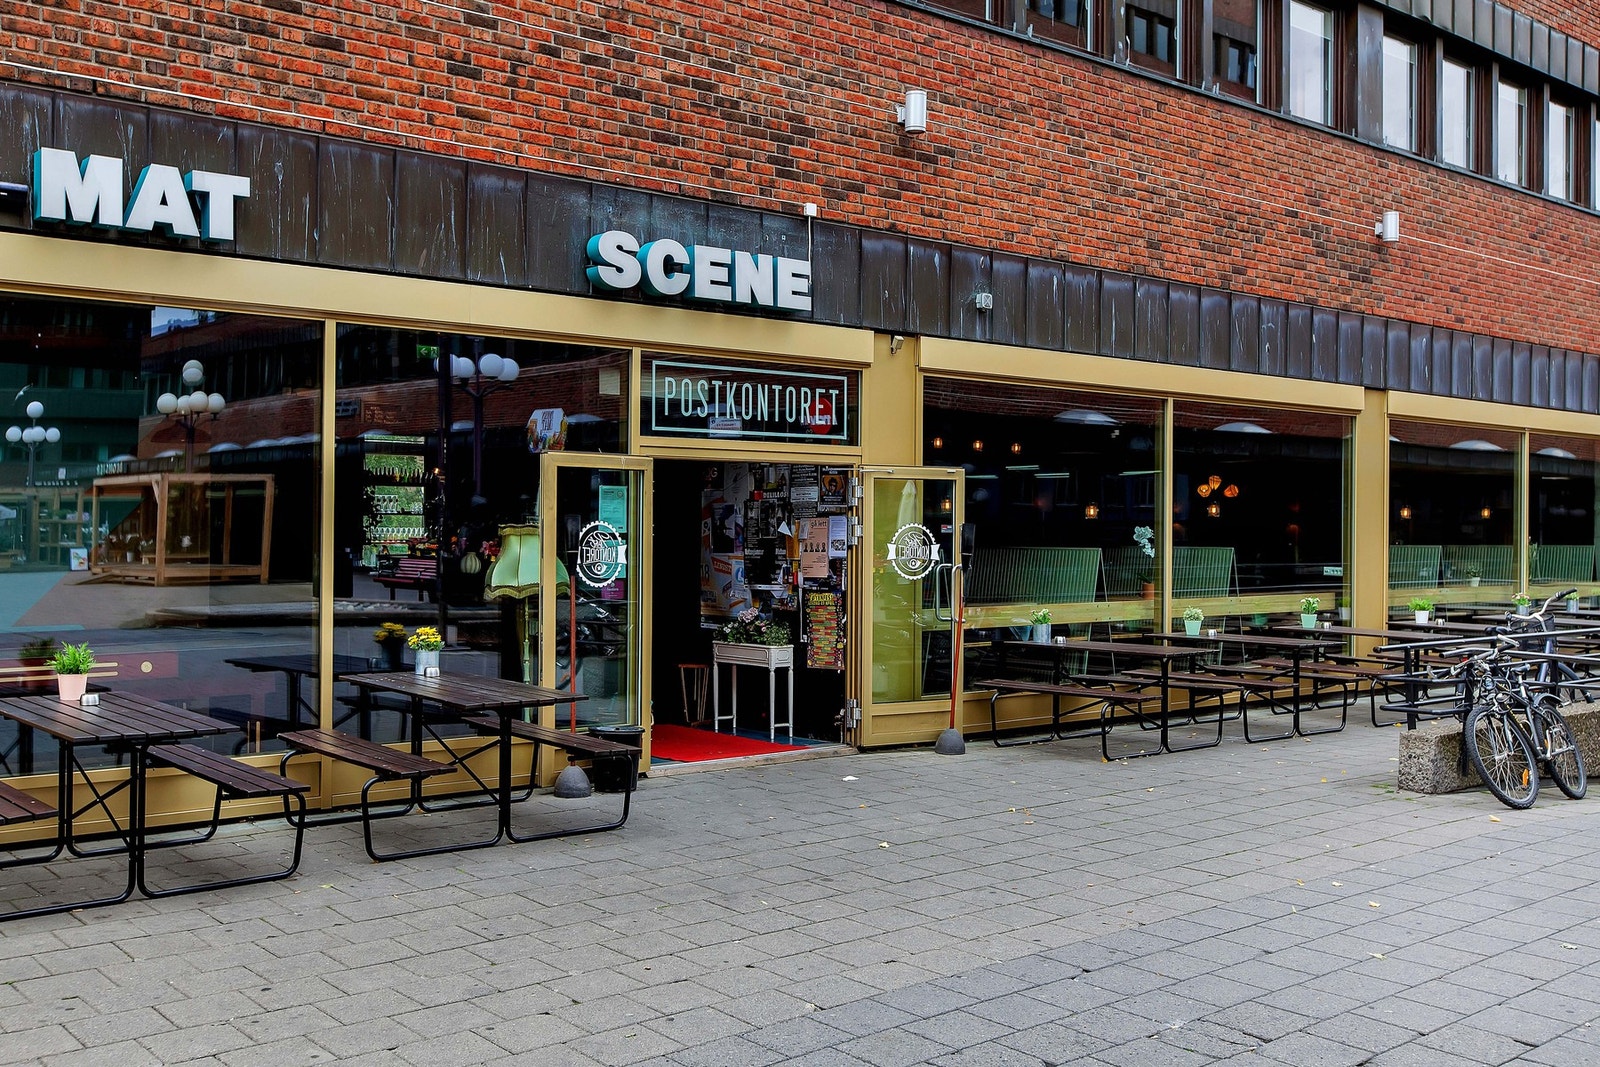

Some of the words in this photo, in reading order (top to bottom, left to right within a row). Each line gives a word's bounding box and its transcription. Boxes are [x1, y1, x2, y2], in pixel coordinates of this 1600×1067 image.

[33, 147, 251, 242] MAT
[586, 229, 813, 312] SCENE
[664, 376, 840, 425] POSTKONTORET
